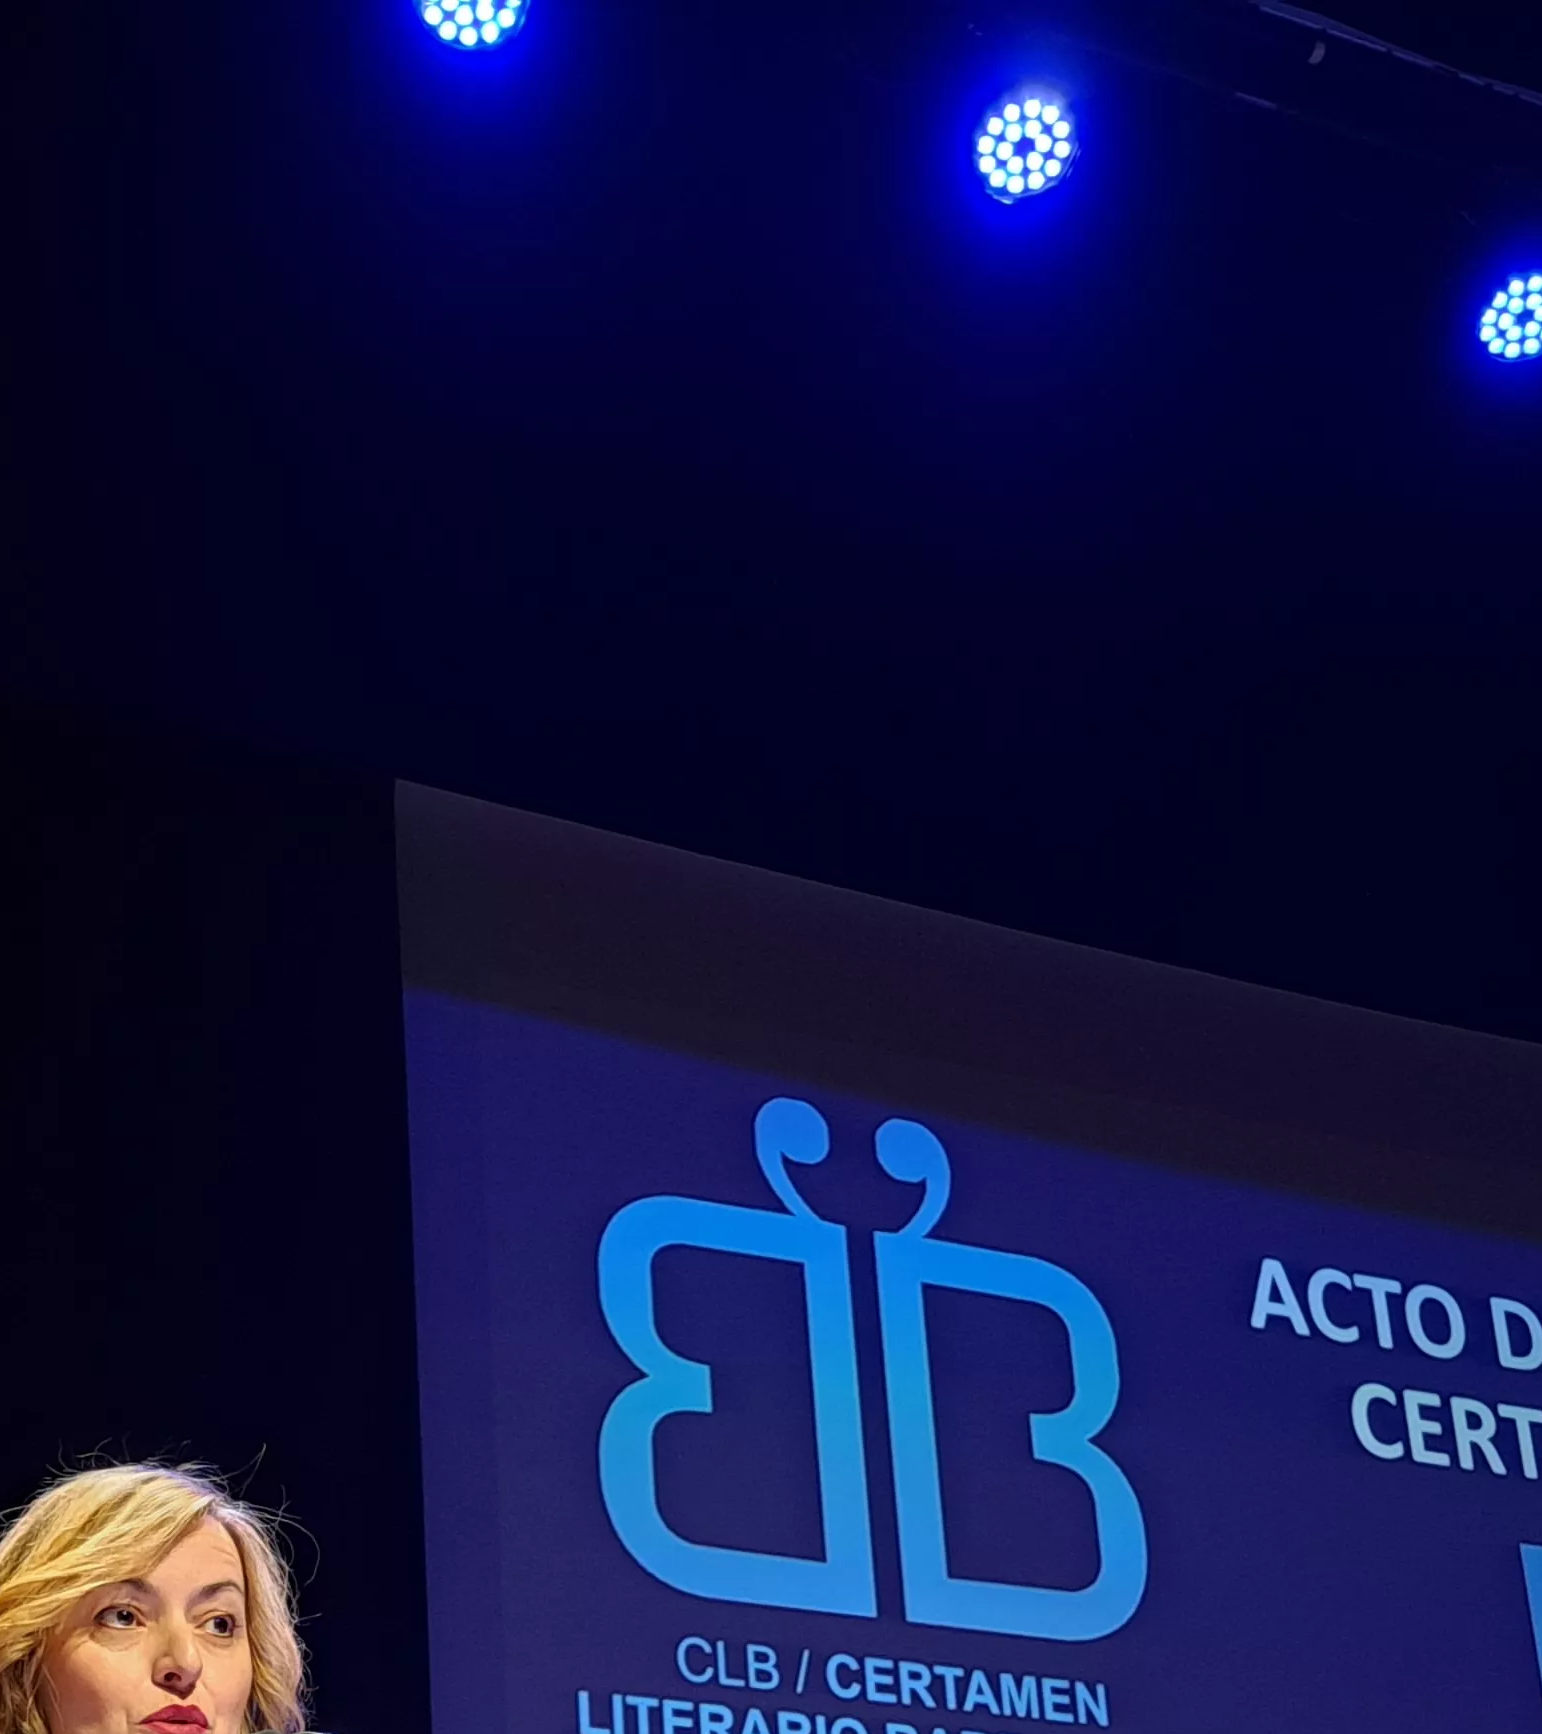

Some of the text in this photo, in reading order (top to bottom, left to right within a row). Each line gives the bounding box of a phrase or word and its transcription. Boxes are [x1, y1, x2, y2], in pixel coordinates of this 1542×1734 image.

[1251, 1258, 1466, 1359] ACTO
[677, 1637, 780, 1690] CLB
[826, 1654, 1109, 1727] CERTAMEN
